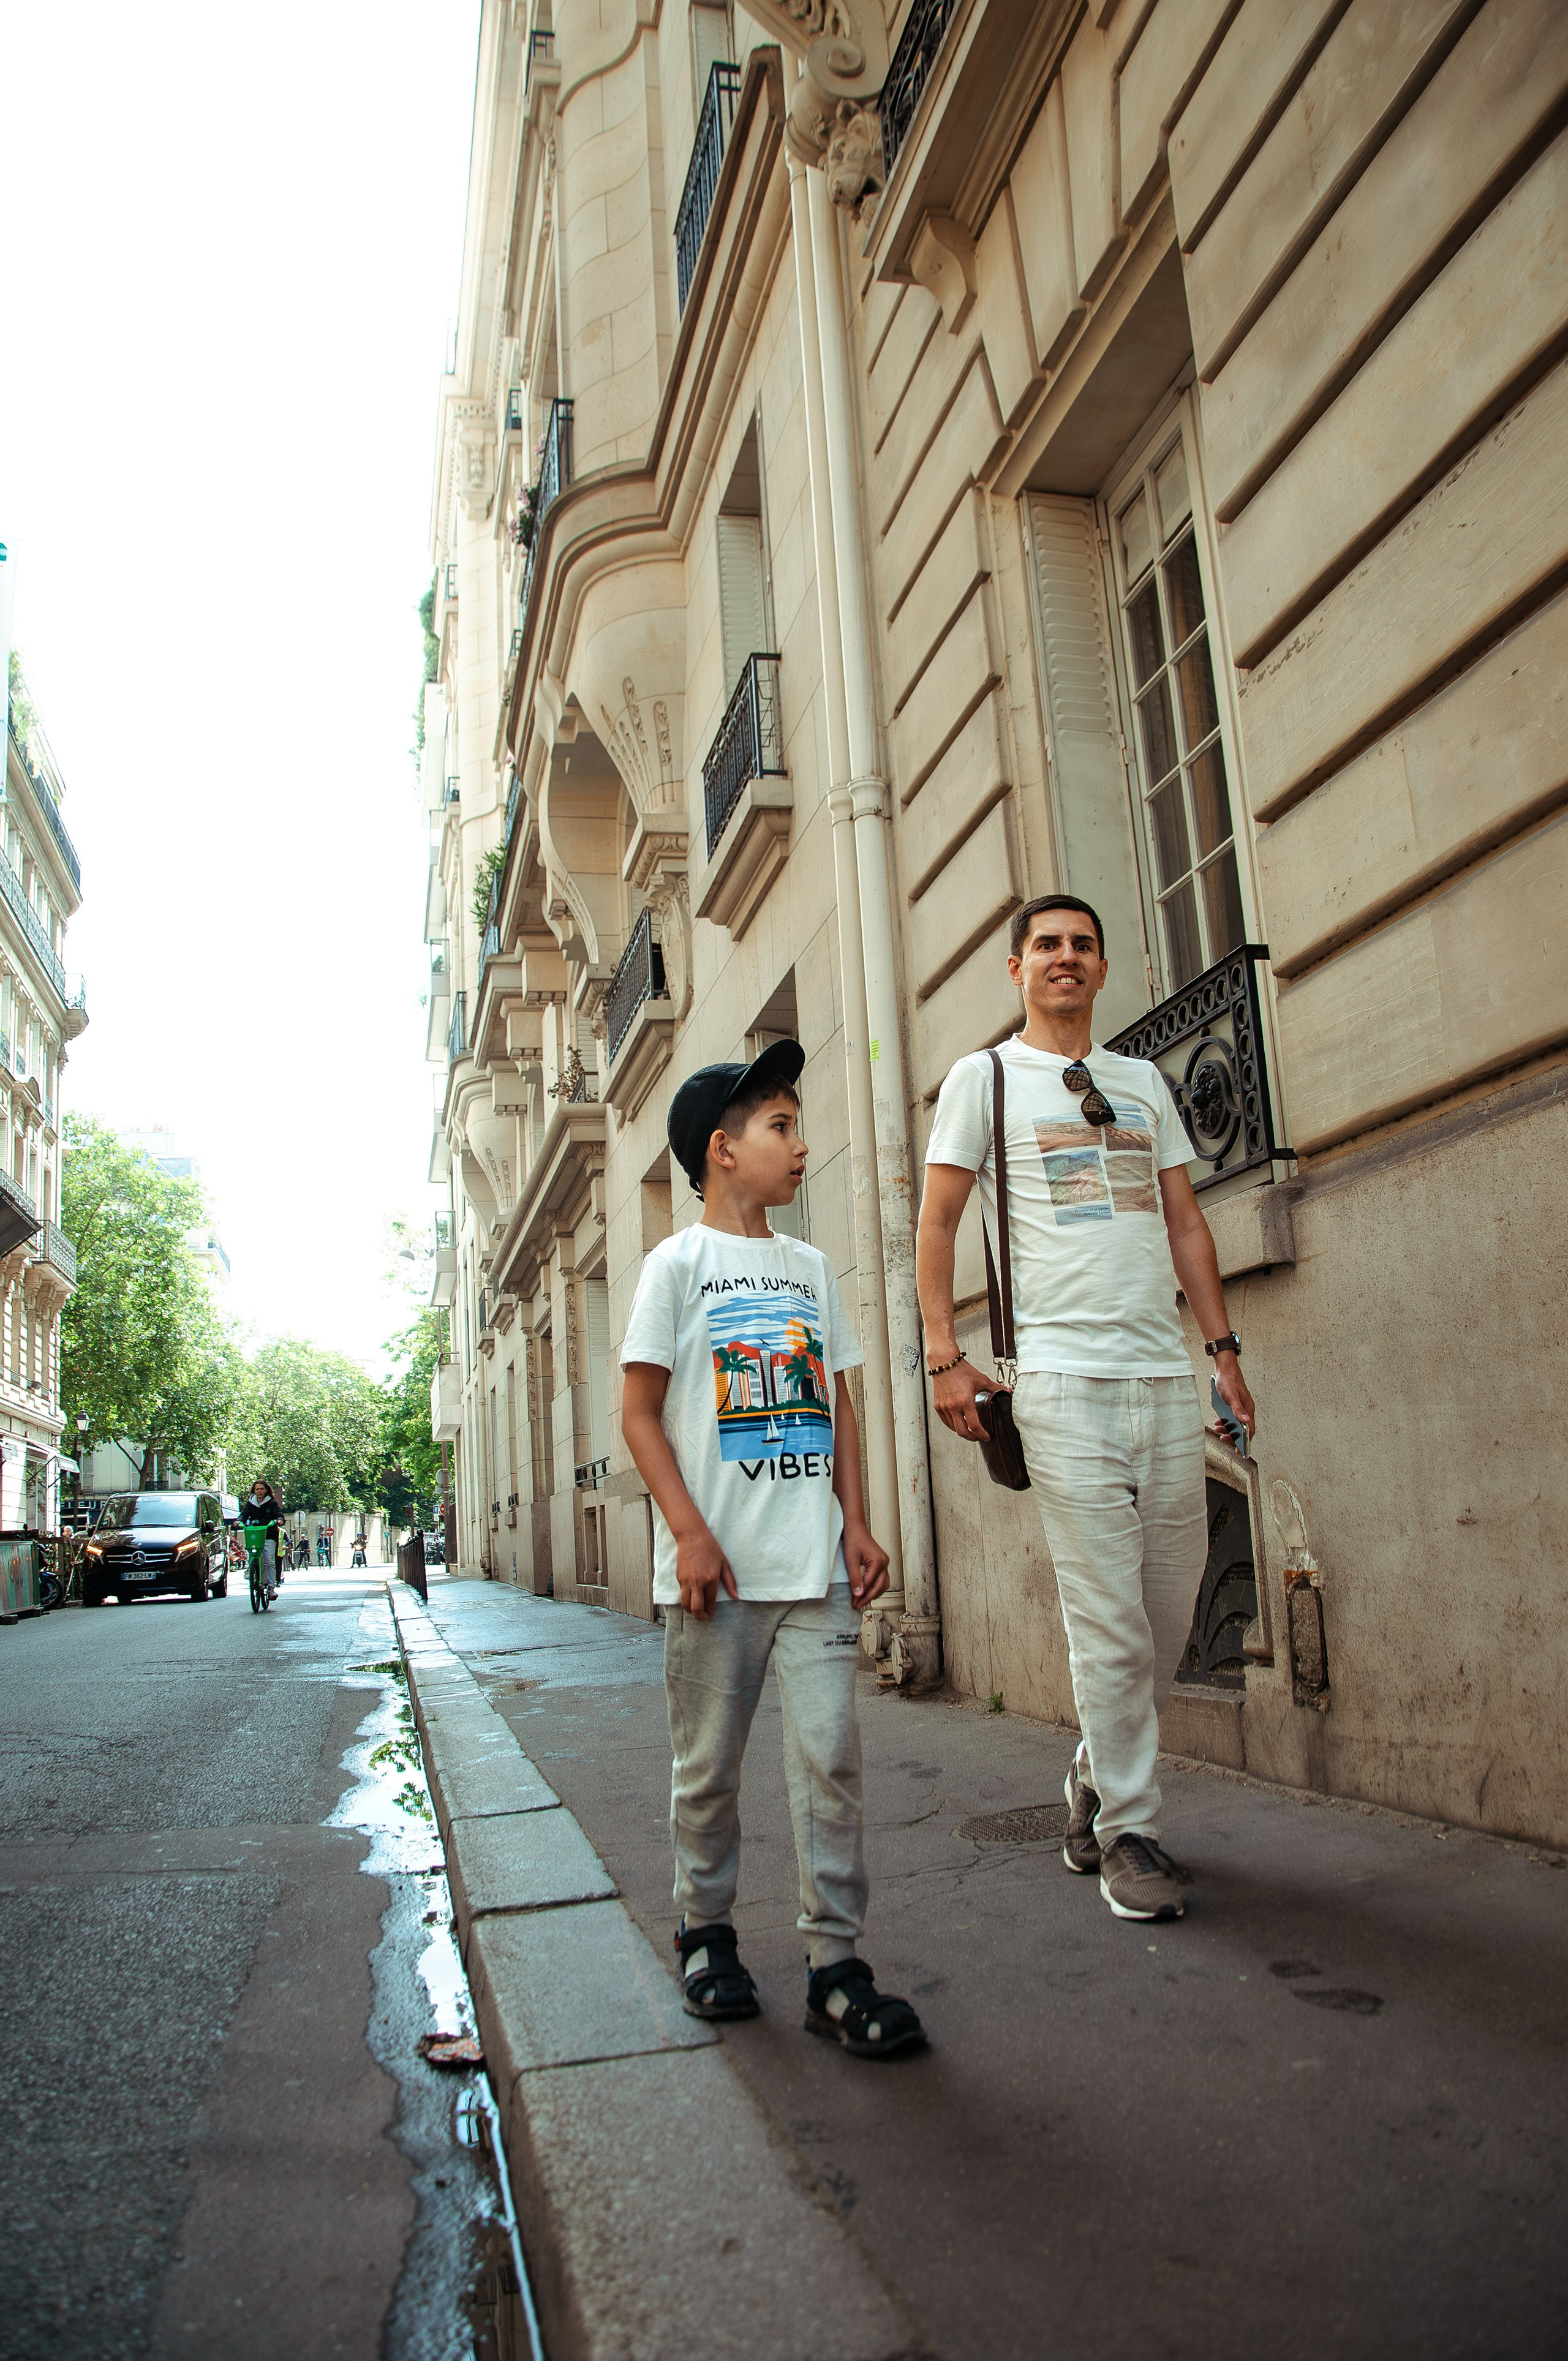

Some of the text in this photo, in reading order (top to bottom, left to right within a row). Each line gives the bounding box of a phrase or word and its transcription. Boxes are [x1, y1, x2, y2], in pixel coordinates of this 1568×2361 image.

[701, 1276, 817, 1301] MIAMI SUMMER
[738, 1452, 831, 1481] VIBES
